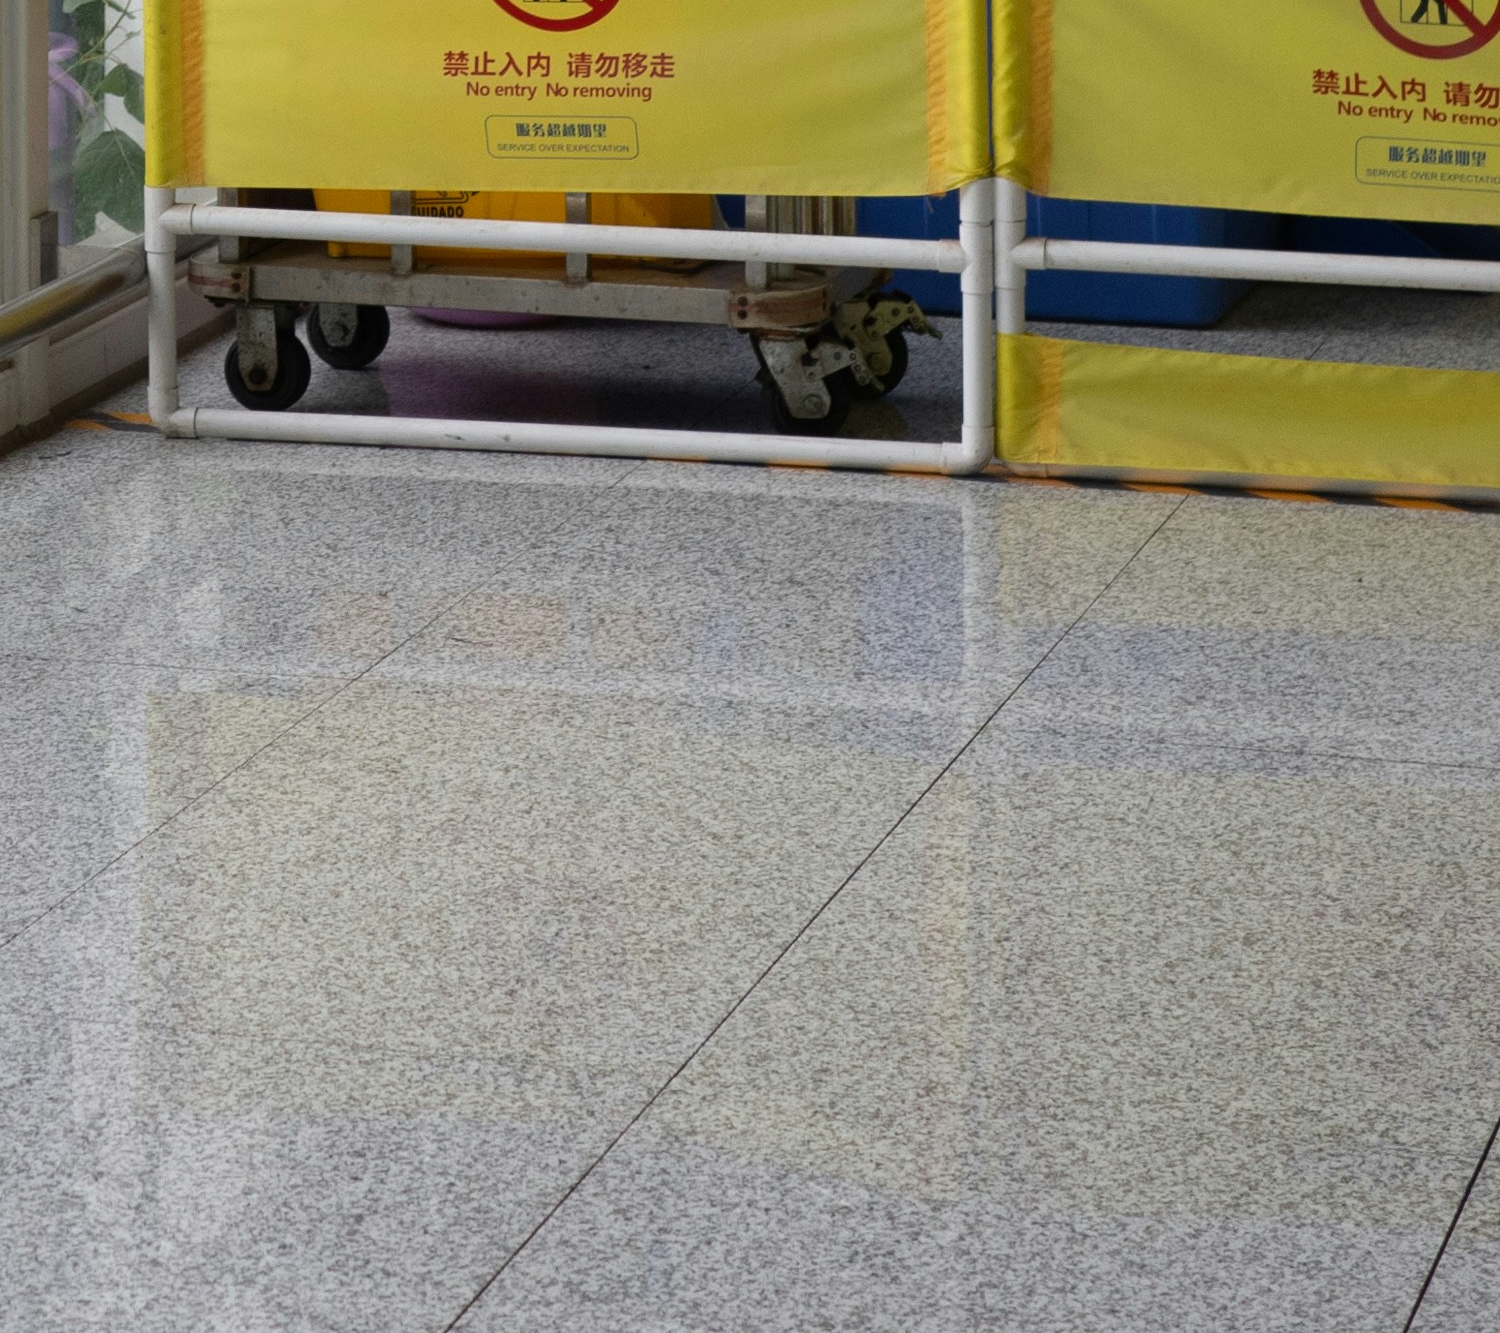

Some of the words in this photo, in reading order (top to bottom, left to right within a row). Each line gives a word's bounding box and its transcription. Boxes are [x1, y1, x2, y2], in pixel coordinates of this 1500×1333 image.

[443, 50, 550, 77] 禁止入内
[567, 52, 675, 79] 请勿移走
[466, 82, 490, 97] No
[495, 84, 537, 101] entry
[546, 83, 568, 98] No
[573, 83, 652, 102] removing
[1312, 68, 1426, 102] 禁止入内
[1337, 100, 1363, 116] No
[1368, 104, 1413, 123] entry
[1423, 107, 1447, 123] No
[516, 123, 607, 138] 服务超越期望
[497, 143, 536, 152] SERVICE
[539, 144, 564, 153] OVER
[566, 144, 630, 153] EXPECTATION
[1388, 145, 1487, 168] 服务超越期望
[1366, 168, 1408, 179] SERVICE
[1410, 171, 1438, 181] OVER
